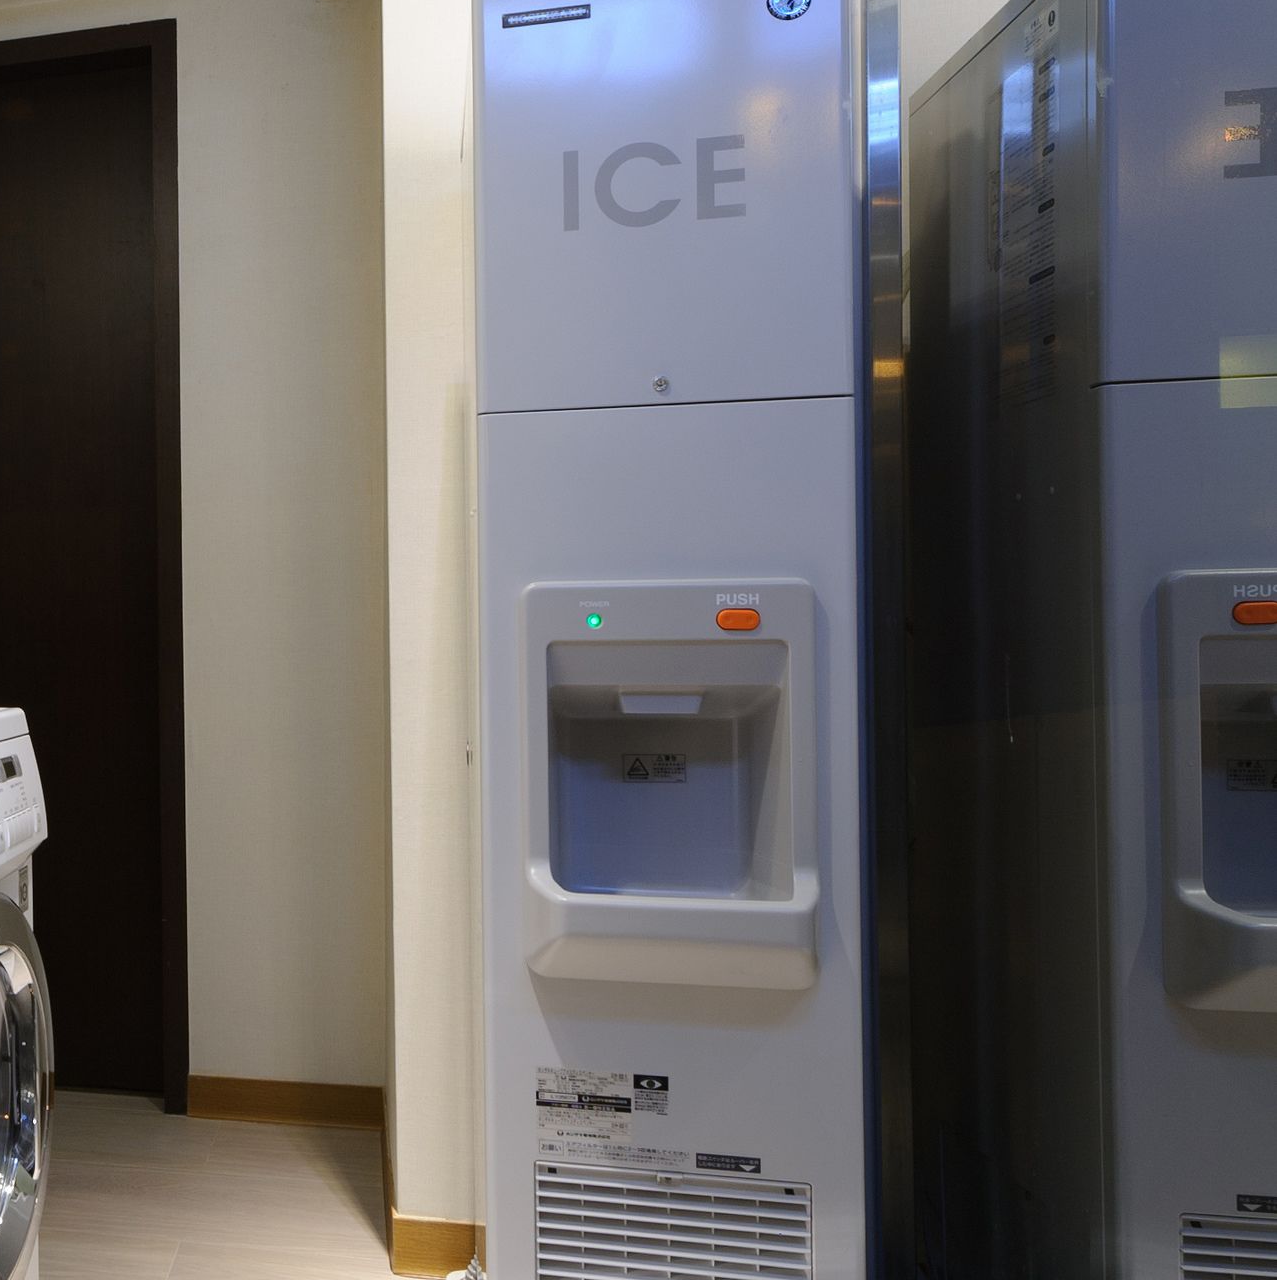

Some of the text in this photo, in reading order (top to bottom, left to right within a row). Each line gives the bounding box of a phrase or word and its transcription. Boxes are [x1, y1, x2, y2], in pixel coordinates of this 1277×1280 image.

[563, 134, 746, 231] ICE
[579, 600, 610, 608] POWER
[716, 593, 760, 605] PUSH
